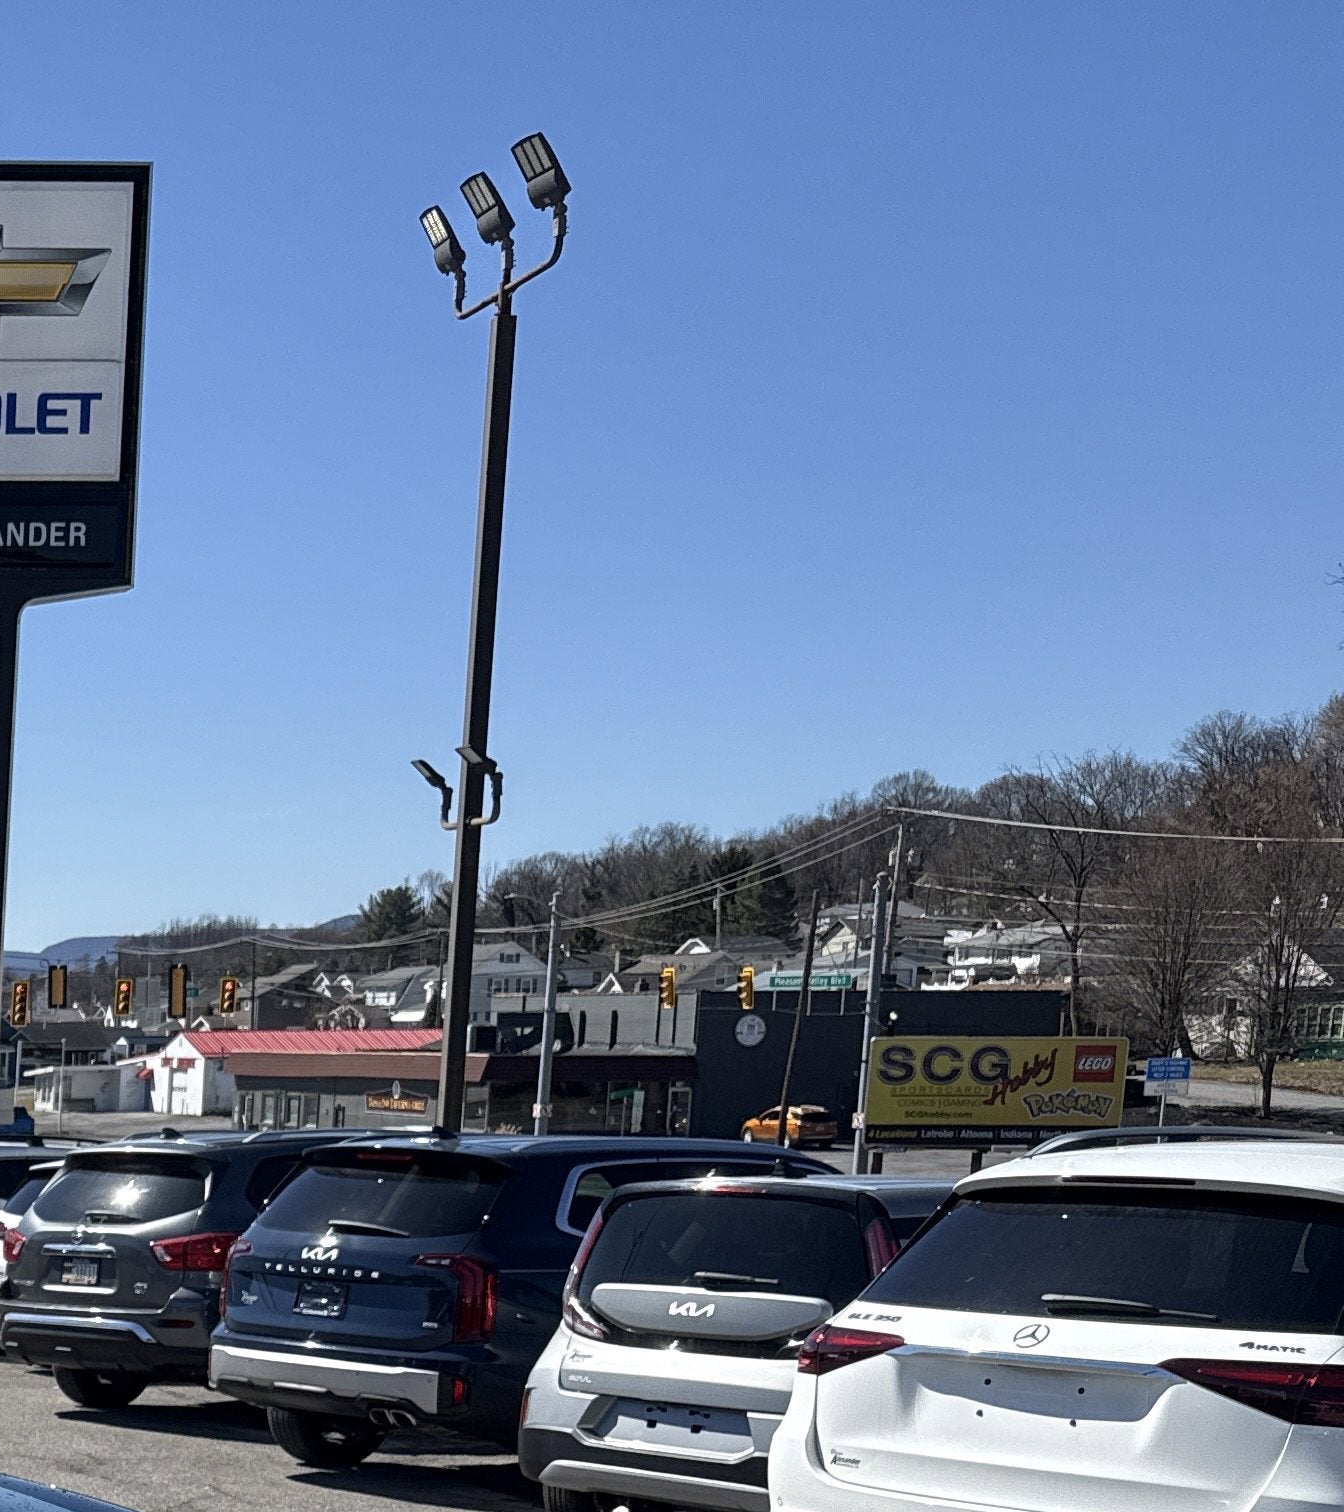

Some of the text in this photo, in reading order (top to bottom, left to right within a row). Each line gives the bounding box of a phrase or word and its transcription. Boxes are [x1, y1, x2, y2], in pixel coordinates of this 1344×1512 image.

[774, 976, 802, 987] Pleasan
[1077, 1055, 1113, 1072] LEGO
[877, 1044, 1058, 1105] SCG Hobby
[890, 1085, 990, 1094] SPORTSCARDS
[897, 1099, 936, 1107] COMICS
[264, 1262, 380, 1279] TELLURIDE
[668, 1300, 716, 1318] KIA
[1238, 1341, 1307, 1355] 4MATIC
